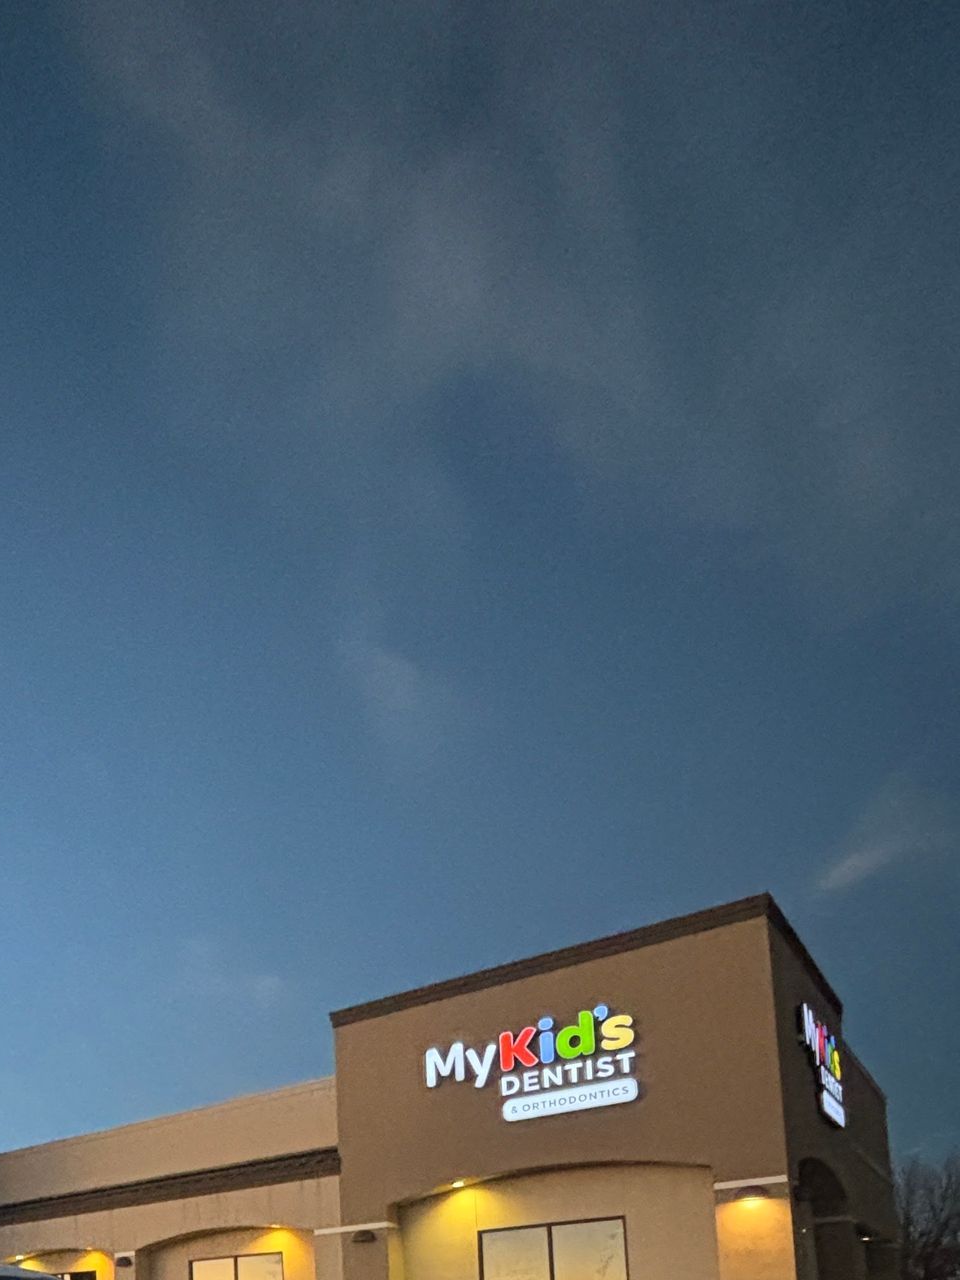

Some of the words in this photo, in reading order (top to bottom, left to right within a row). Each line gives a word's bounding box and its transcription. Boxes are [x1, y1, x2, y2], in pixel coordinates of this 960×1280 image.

[500, 1050, 636, 1097] DENTIST
[511, 1105, 518, 1114] &
[522, 1086, 630, 1112] ORTHODONTICS
